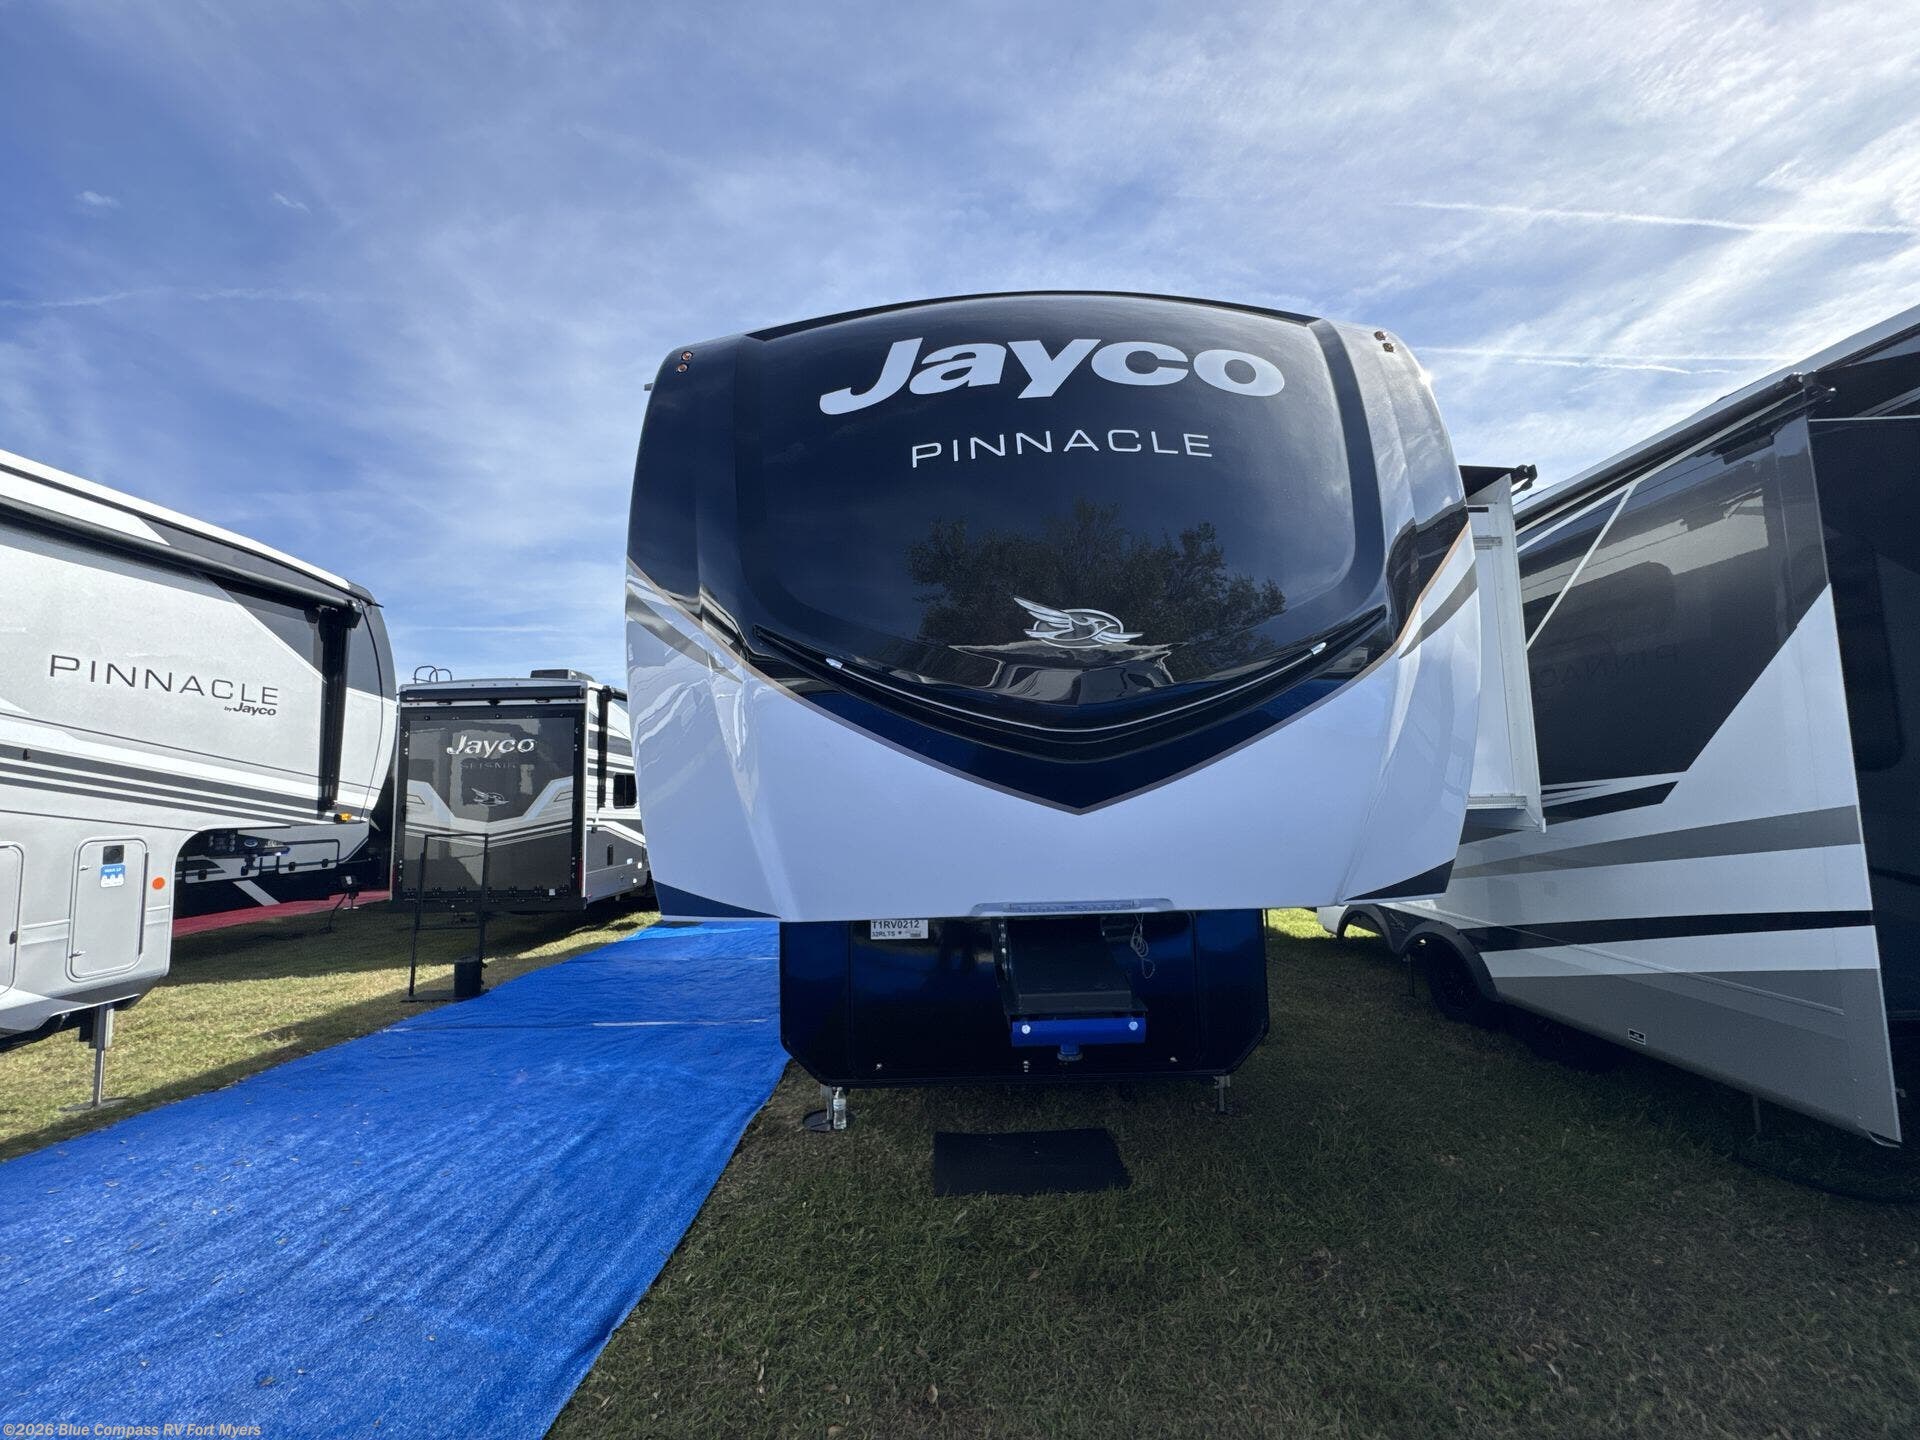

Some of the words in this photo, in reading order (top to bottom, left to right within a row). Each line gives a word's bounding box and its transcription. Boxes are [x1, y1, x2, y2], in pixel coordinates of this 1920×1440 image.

[819, 337, 1285, 416] Jayco
[911, 429, 1213, 468] PINNACLE
[50, 654, 279, 706] PINNACLE
[233, 703, 276, 716] Jayco
[446, 734, 537, 758] Jayco
[872, 920, 920, 929] T1RV0212
